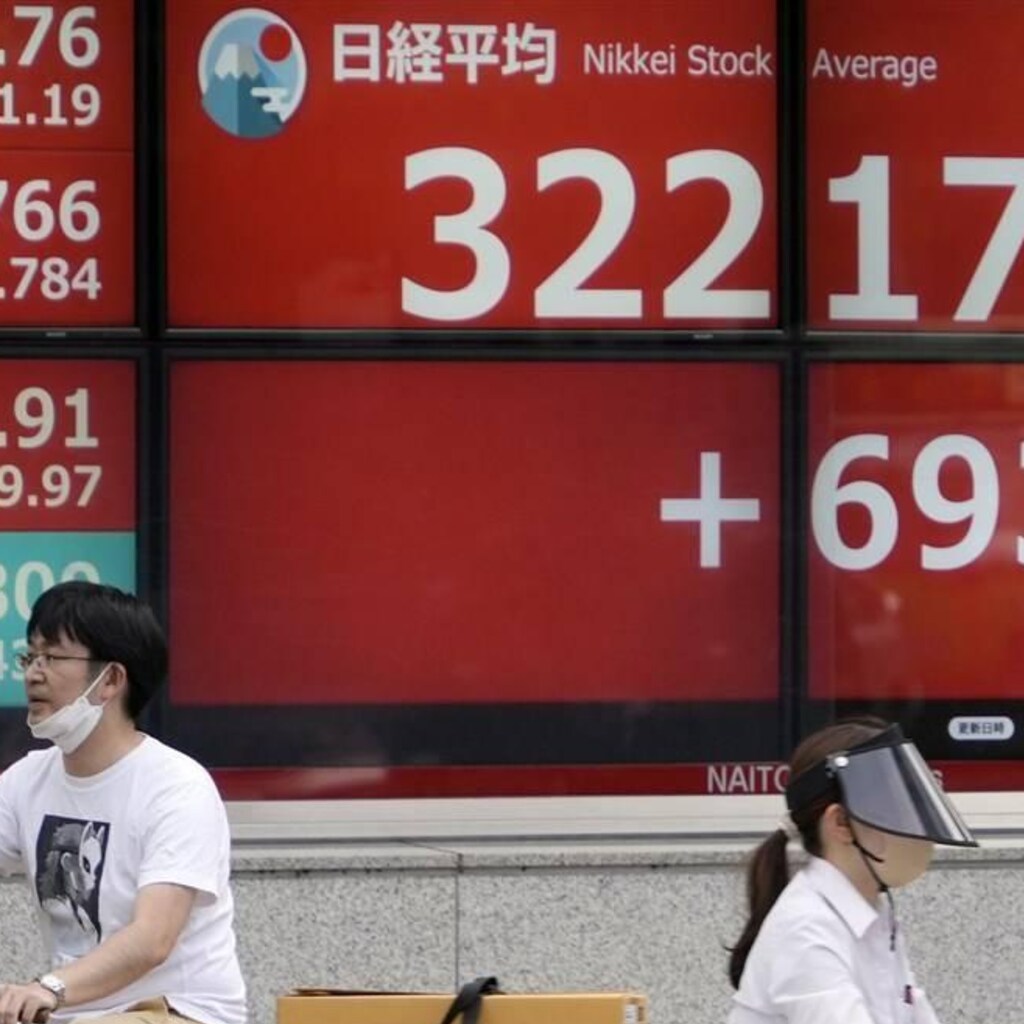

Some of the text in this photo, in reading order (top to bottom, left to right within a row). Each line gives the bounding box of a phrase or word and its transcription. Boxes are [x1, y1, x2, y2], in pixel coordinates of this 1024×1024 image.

[332, 22, 557, 84] 日経平均
[583, 42, 938, 88] Nikkei Stock Average
[0, 82, 101, 126] 1.19
[0, 179, 101, 242] 66
[0, 464, 102, 508] 9.97
